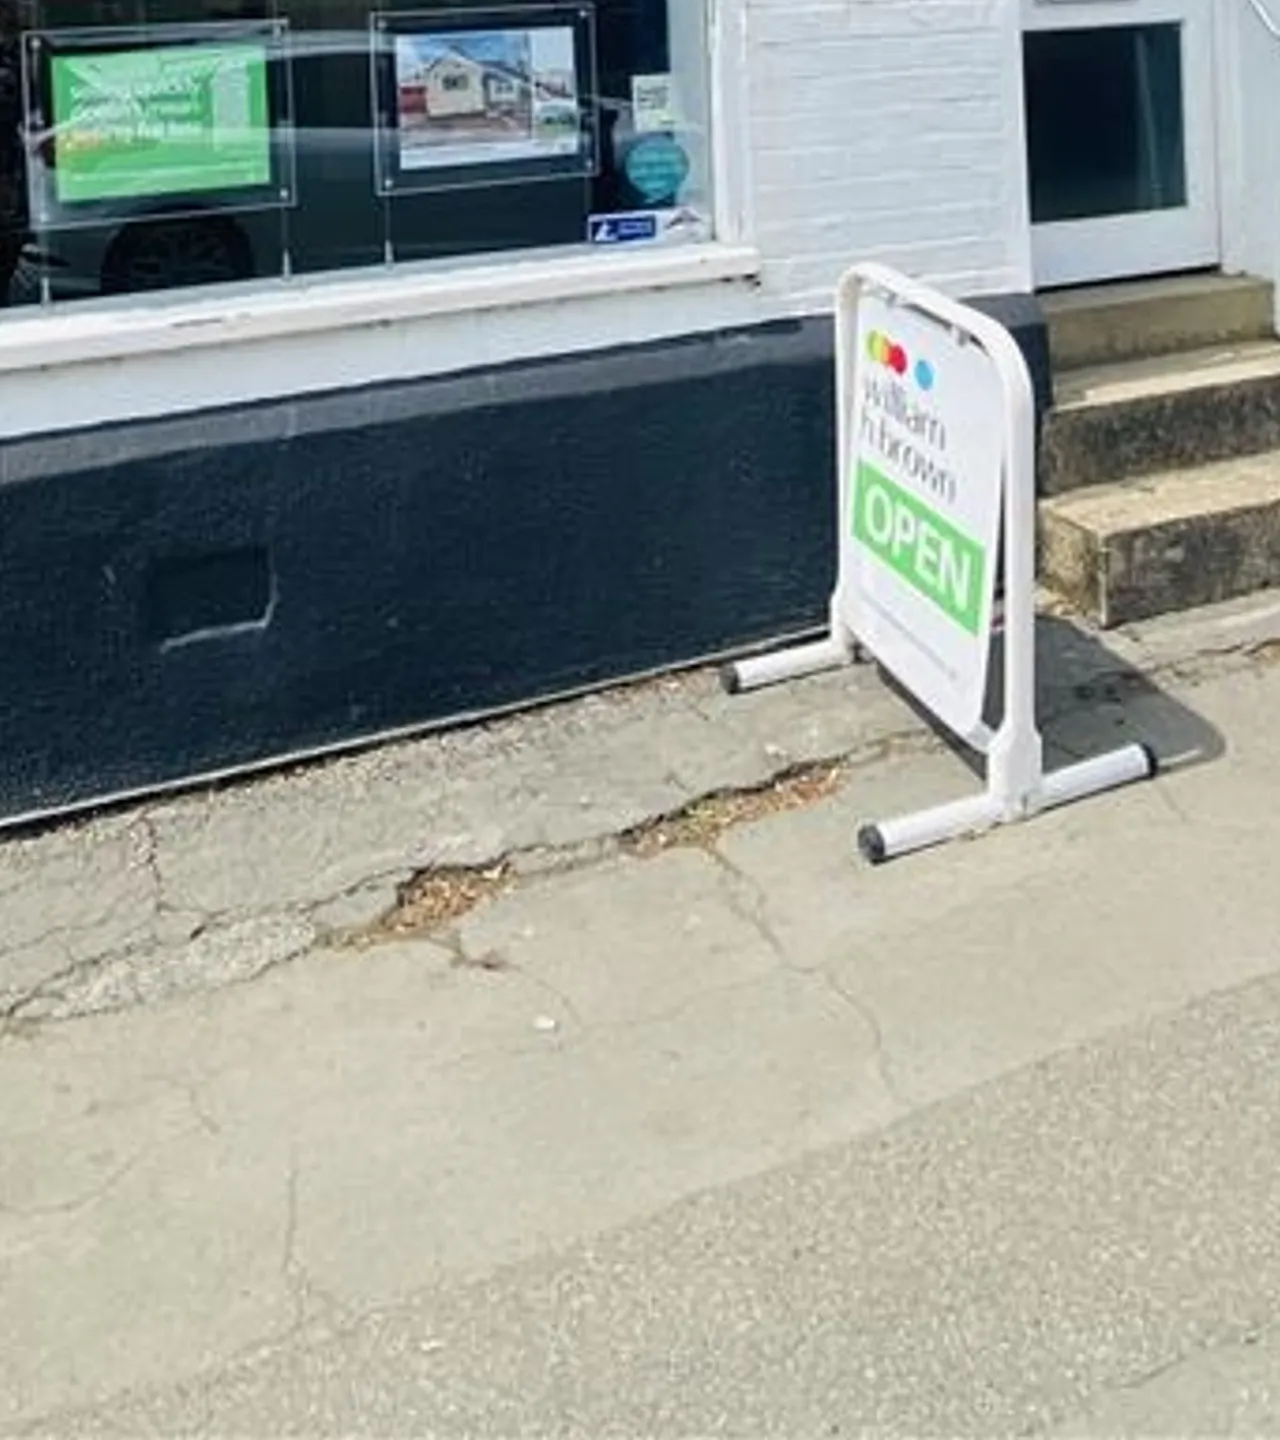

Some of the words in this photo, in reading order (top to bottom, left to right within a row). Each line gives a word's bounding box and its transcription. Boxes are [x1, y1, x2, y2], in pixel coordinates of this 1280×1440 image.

[861, 405, 875, 446] h
[880, 417, 958, 504] brown
[863, 377, 947, 450] william
[864, 482, 973, 612] OPEN
